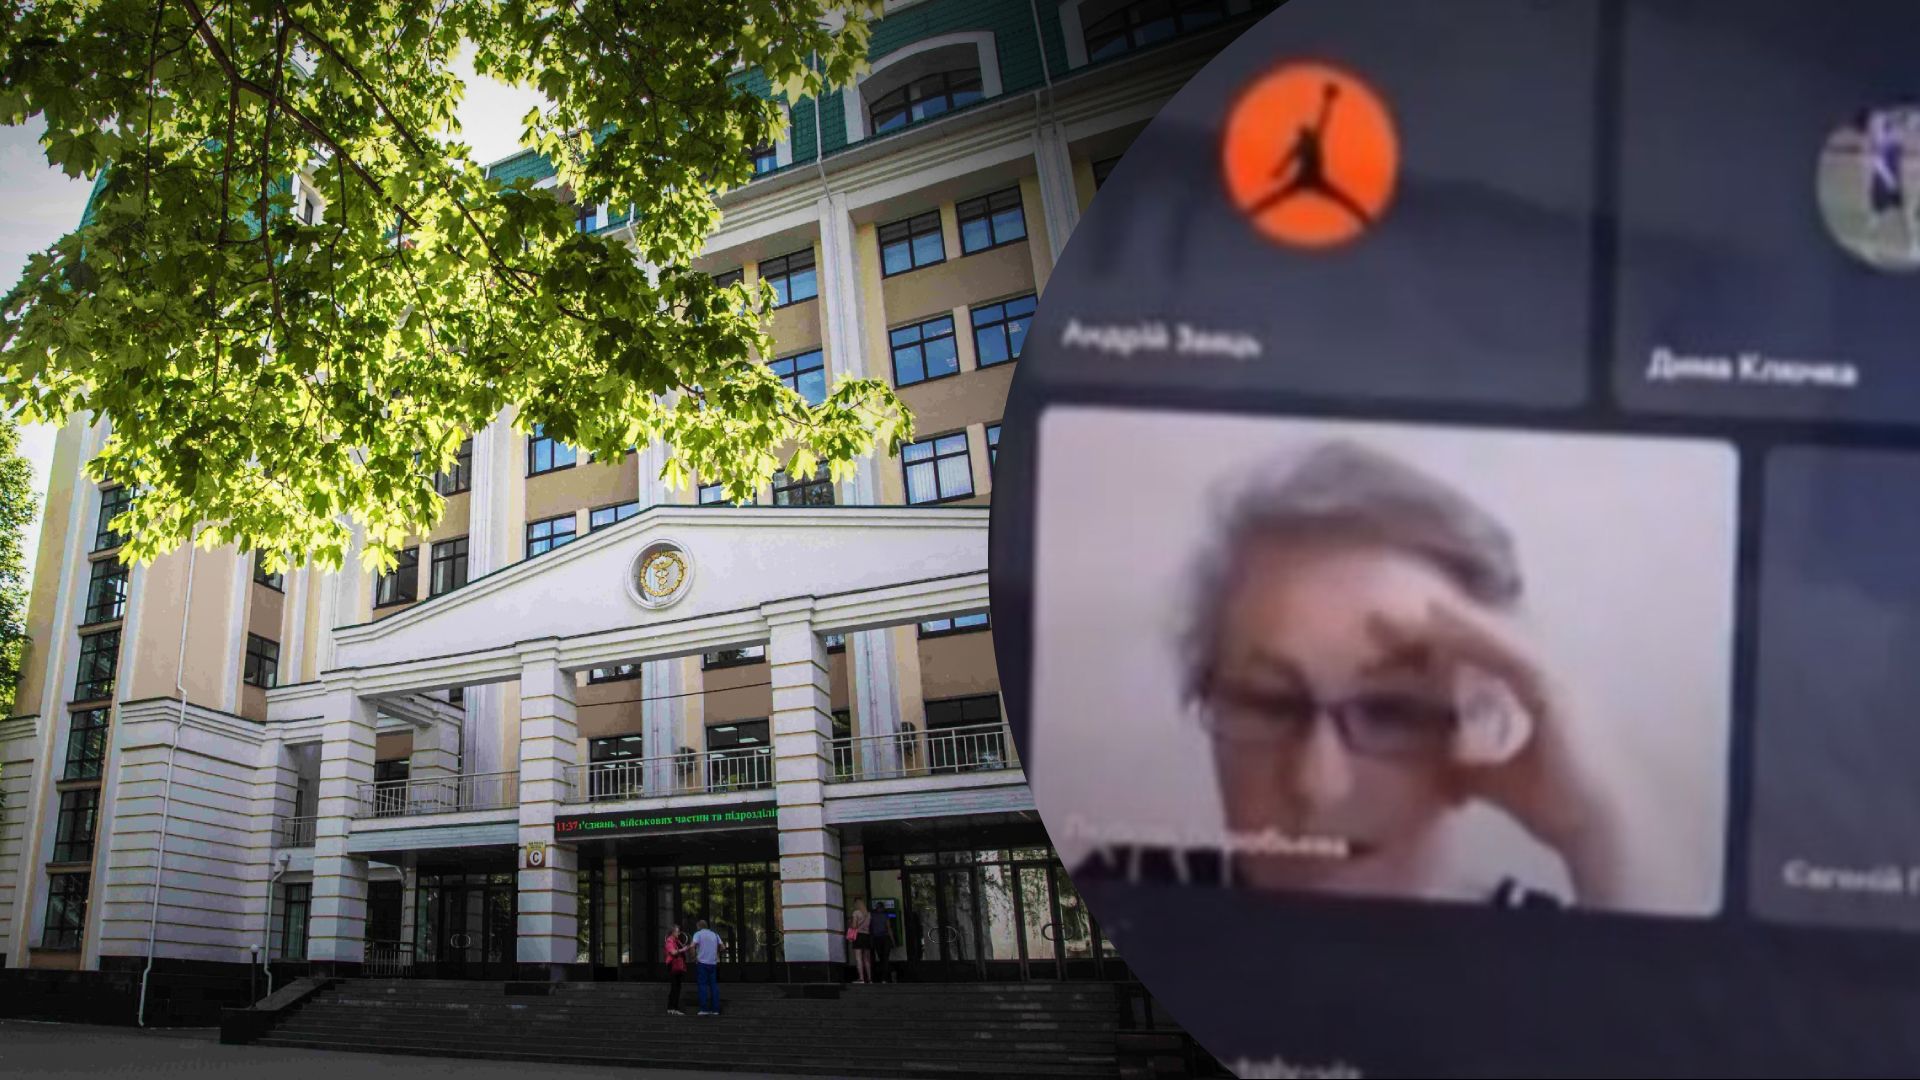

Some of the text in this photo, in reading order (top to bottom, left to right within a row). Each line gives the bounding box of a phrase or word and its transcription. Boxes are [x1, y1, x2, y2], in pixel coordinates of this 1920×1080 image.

[556, 820, 578, 833] 11:37
[620, 816, 672, 828] військових
[675, 813, 709, 825] частин
[711, 812, 722, 822] та
